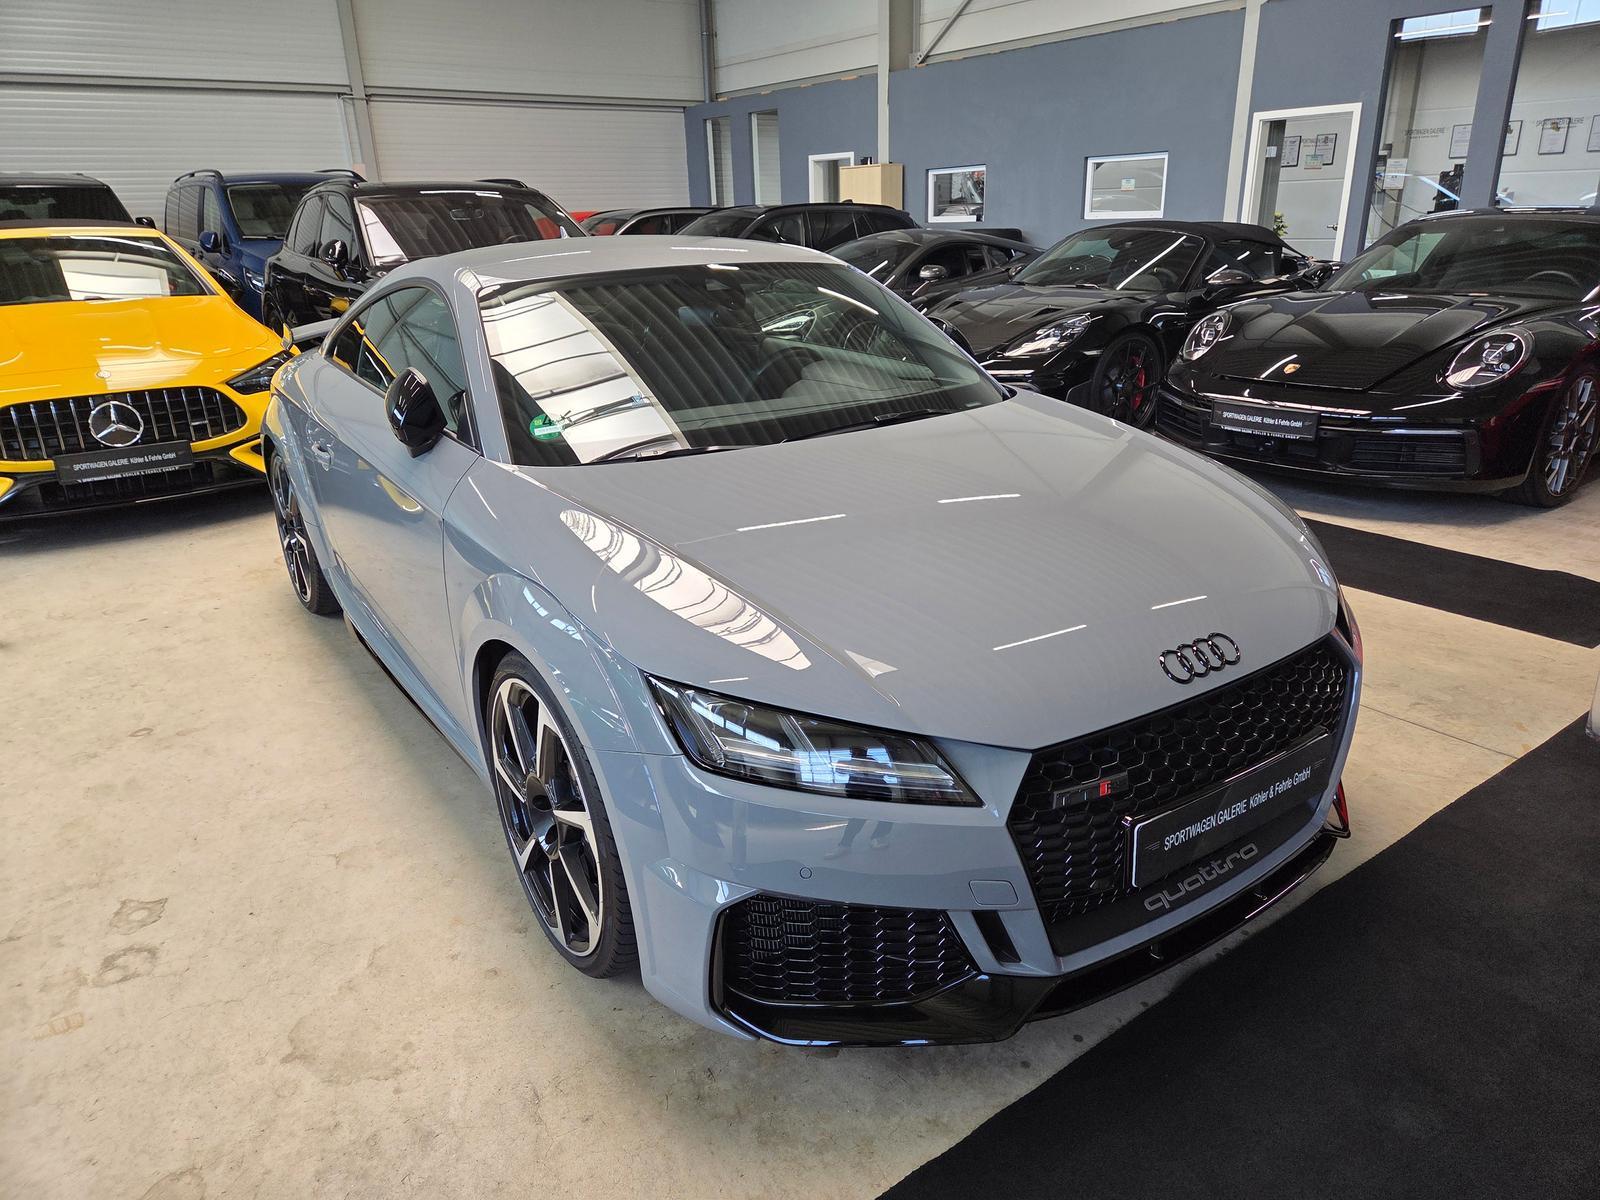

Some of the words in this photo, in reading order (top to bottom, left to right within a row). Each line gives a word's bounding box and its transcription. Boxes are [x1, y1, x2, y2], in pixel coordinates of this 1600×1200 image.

[73, 461, 108, 471] SPORTWAGEN
[108, 457, 129, 467] GALERIE
[162, 452, 176, 460] GmbH
[1164, 814, 1217, 851] SPORTWAGEN
[1217, 799, 1248, 825] GALERIE
[1249, 788, 1269, 809] Köhler
[1269, 785, 1274, 799] &
[1274, 779, 1293, 798] Fehrle
[1293, 765, 1312, 789] GmbH
[1143, 842, 1259, 912] quattro
